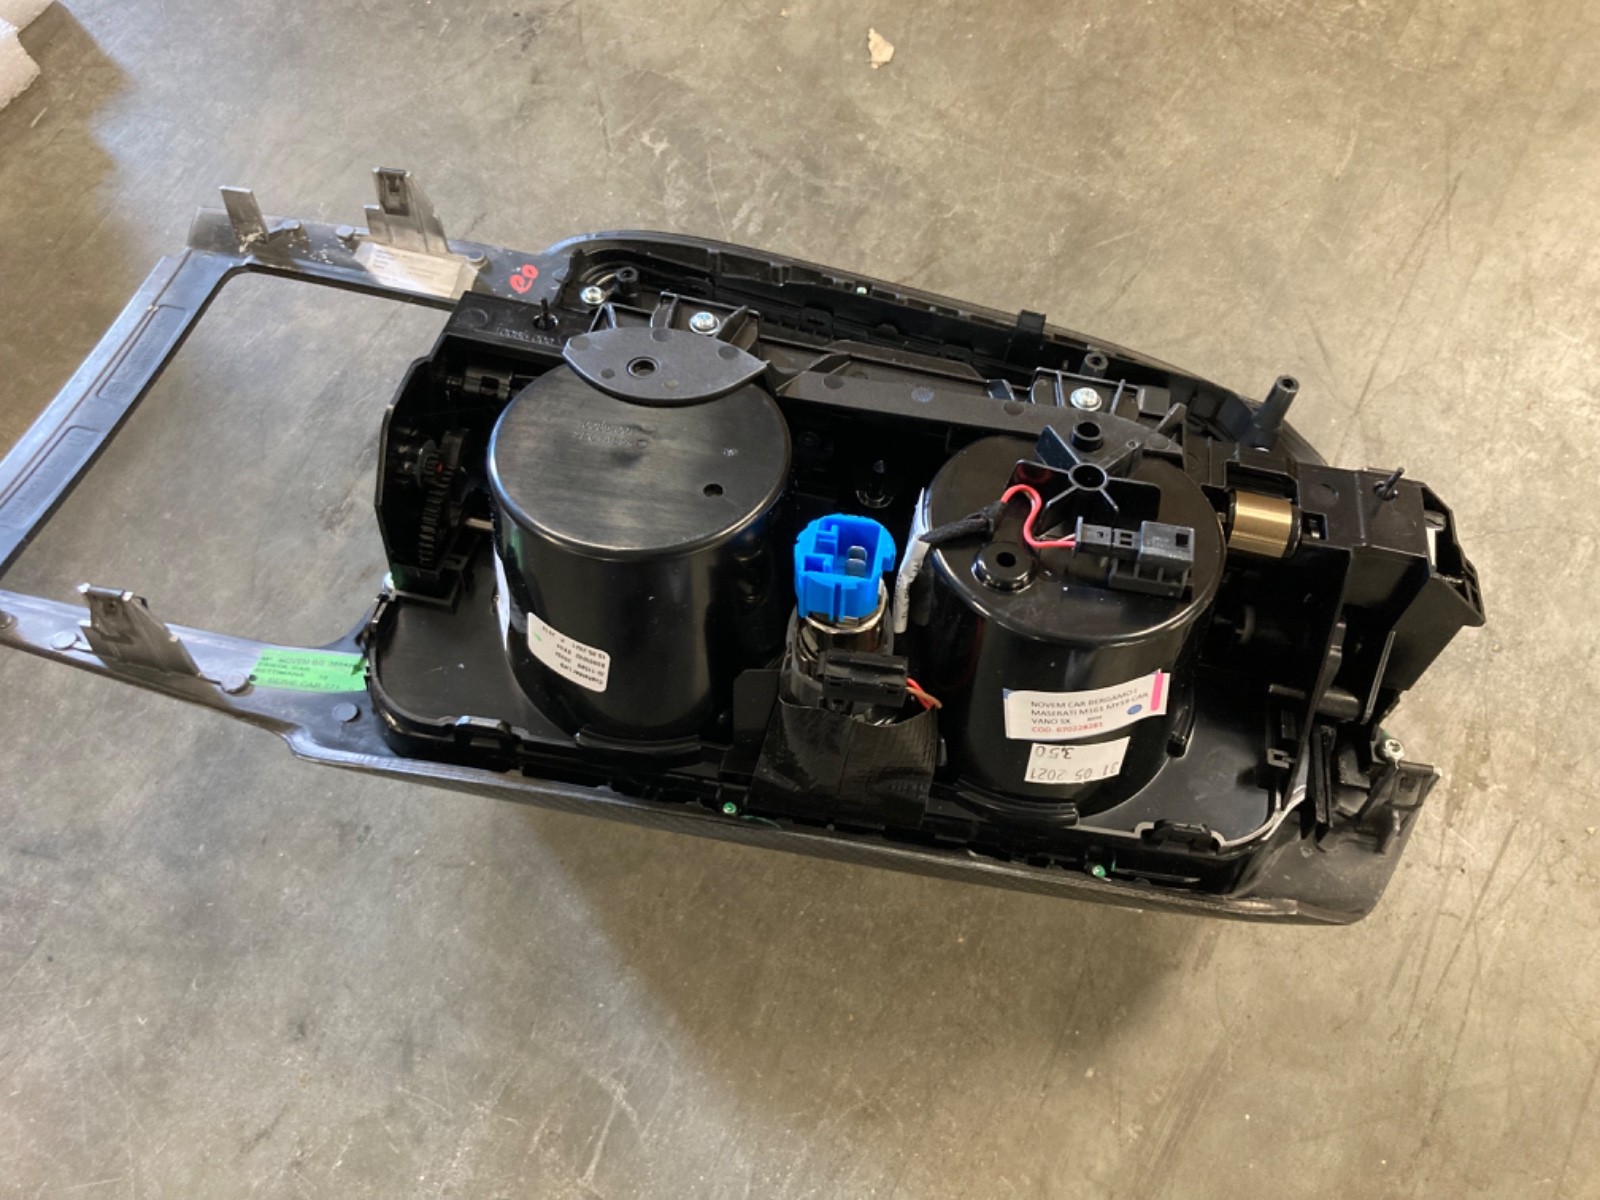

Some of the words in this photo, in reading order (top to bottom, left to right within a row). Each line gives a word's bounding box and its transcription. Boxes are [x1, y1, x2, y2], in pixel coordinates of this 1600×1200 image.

[1088, 690, 1133, 705] BERGAMO
[1030, 768, 1066, 780] 2021
[1076, 769, 1092, 780] 05
